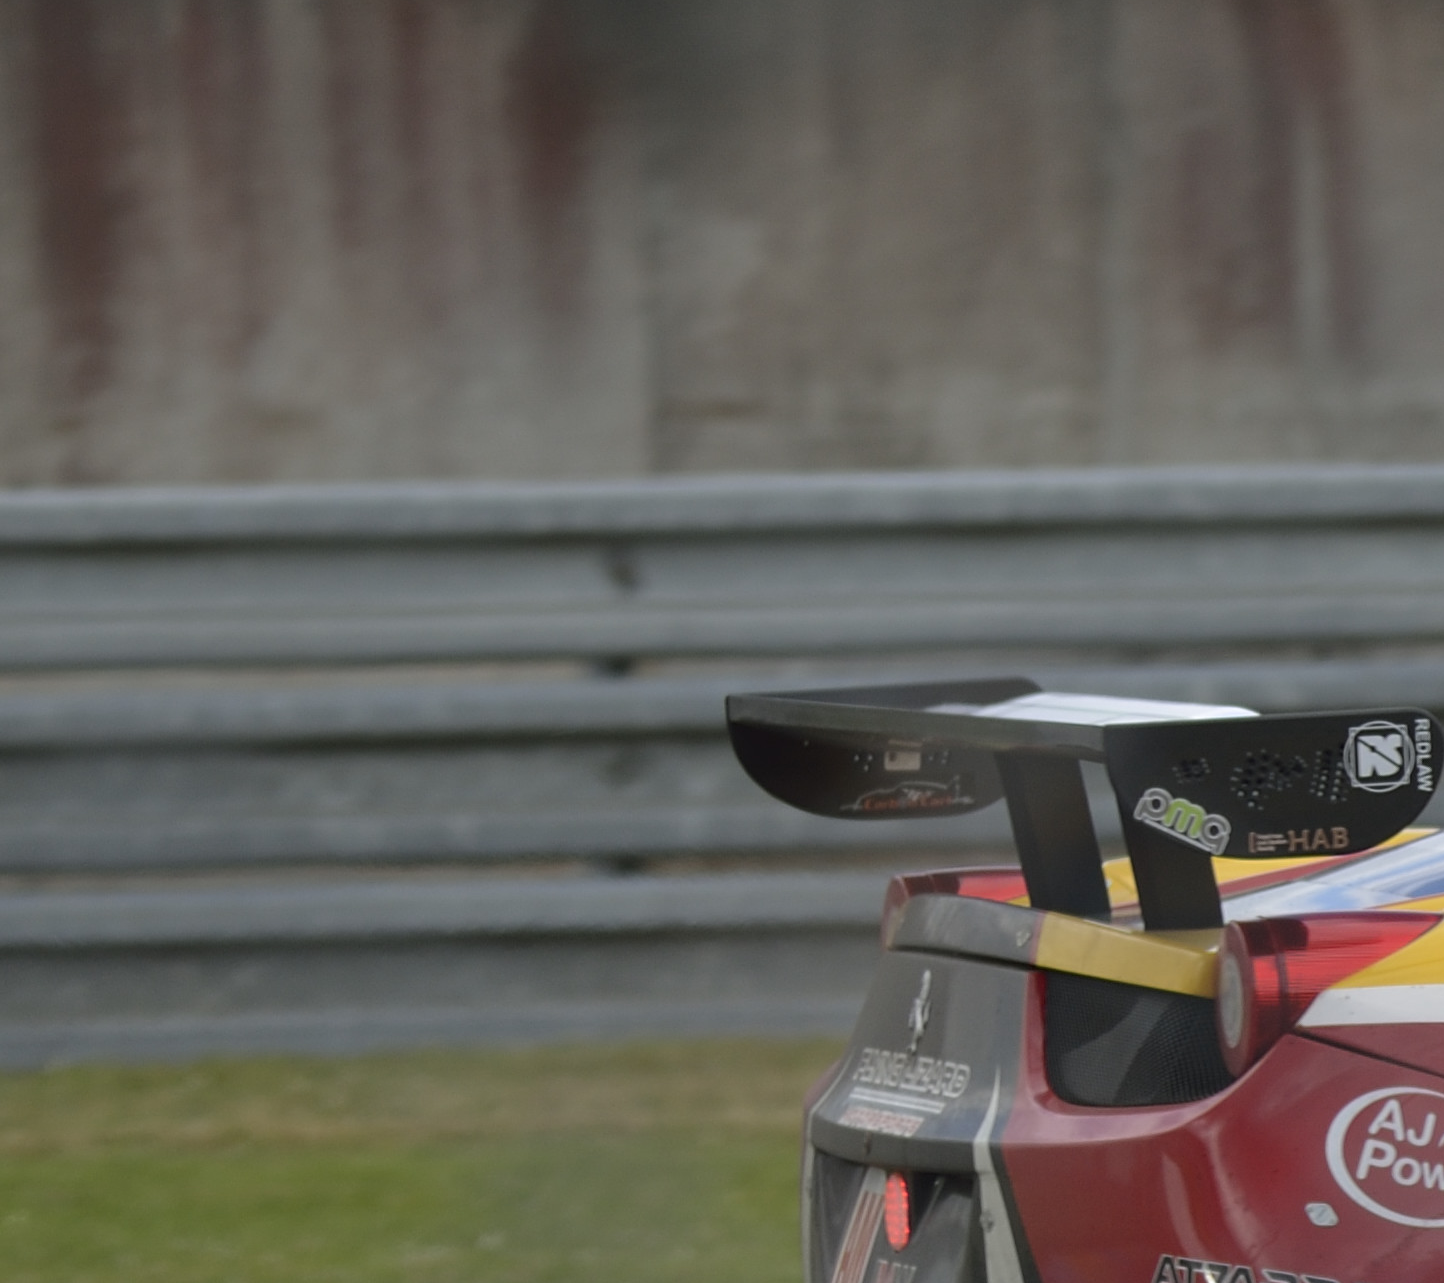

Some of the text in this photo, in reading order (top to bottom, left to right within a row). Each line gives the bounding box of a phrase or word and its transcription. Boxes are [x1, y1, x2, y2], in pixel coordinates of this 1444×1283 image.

[1414, 718, 1433, 792] REDLAW
[1134, 788, 1232, 855] pmg
[1287, 827, 1349, 851] HAB
[1368, 1097, 1436, 1147] AJ
